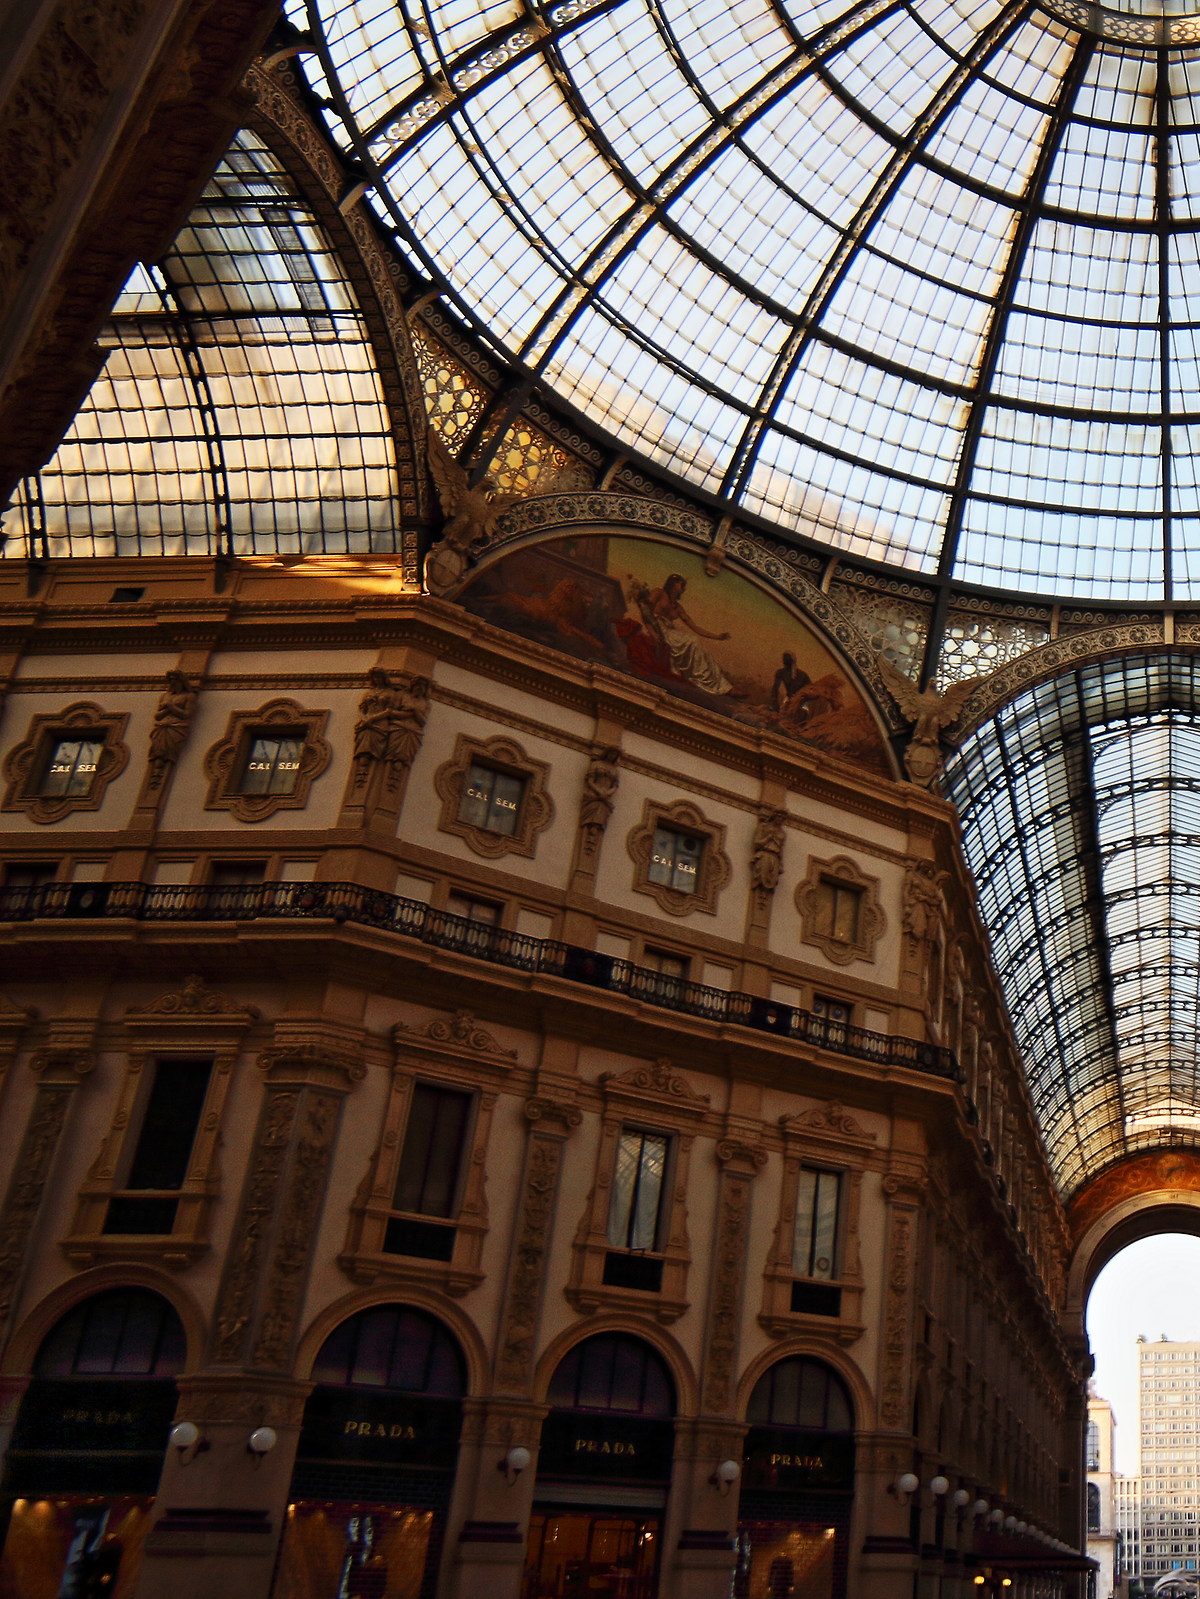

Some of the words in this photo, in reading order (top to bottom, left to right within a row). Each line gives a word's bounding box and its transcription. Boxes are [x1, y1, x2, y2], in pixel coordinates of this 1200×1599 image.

[342, 1420, 416, 1439] PRADA
[575, 1439, 636, 1456] PRADA
[769, 1453, 824, 1469] PRADA
